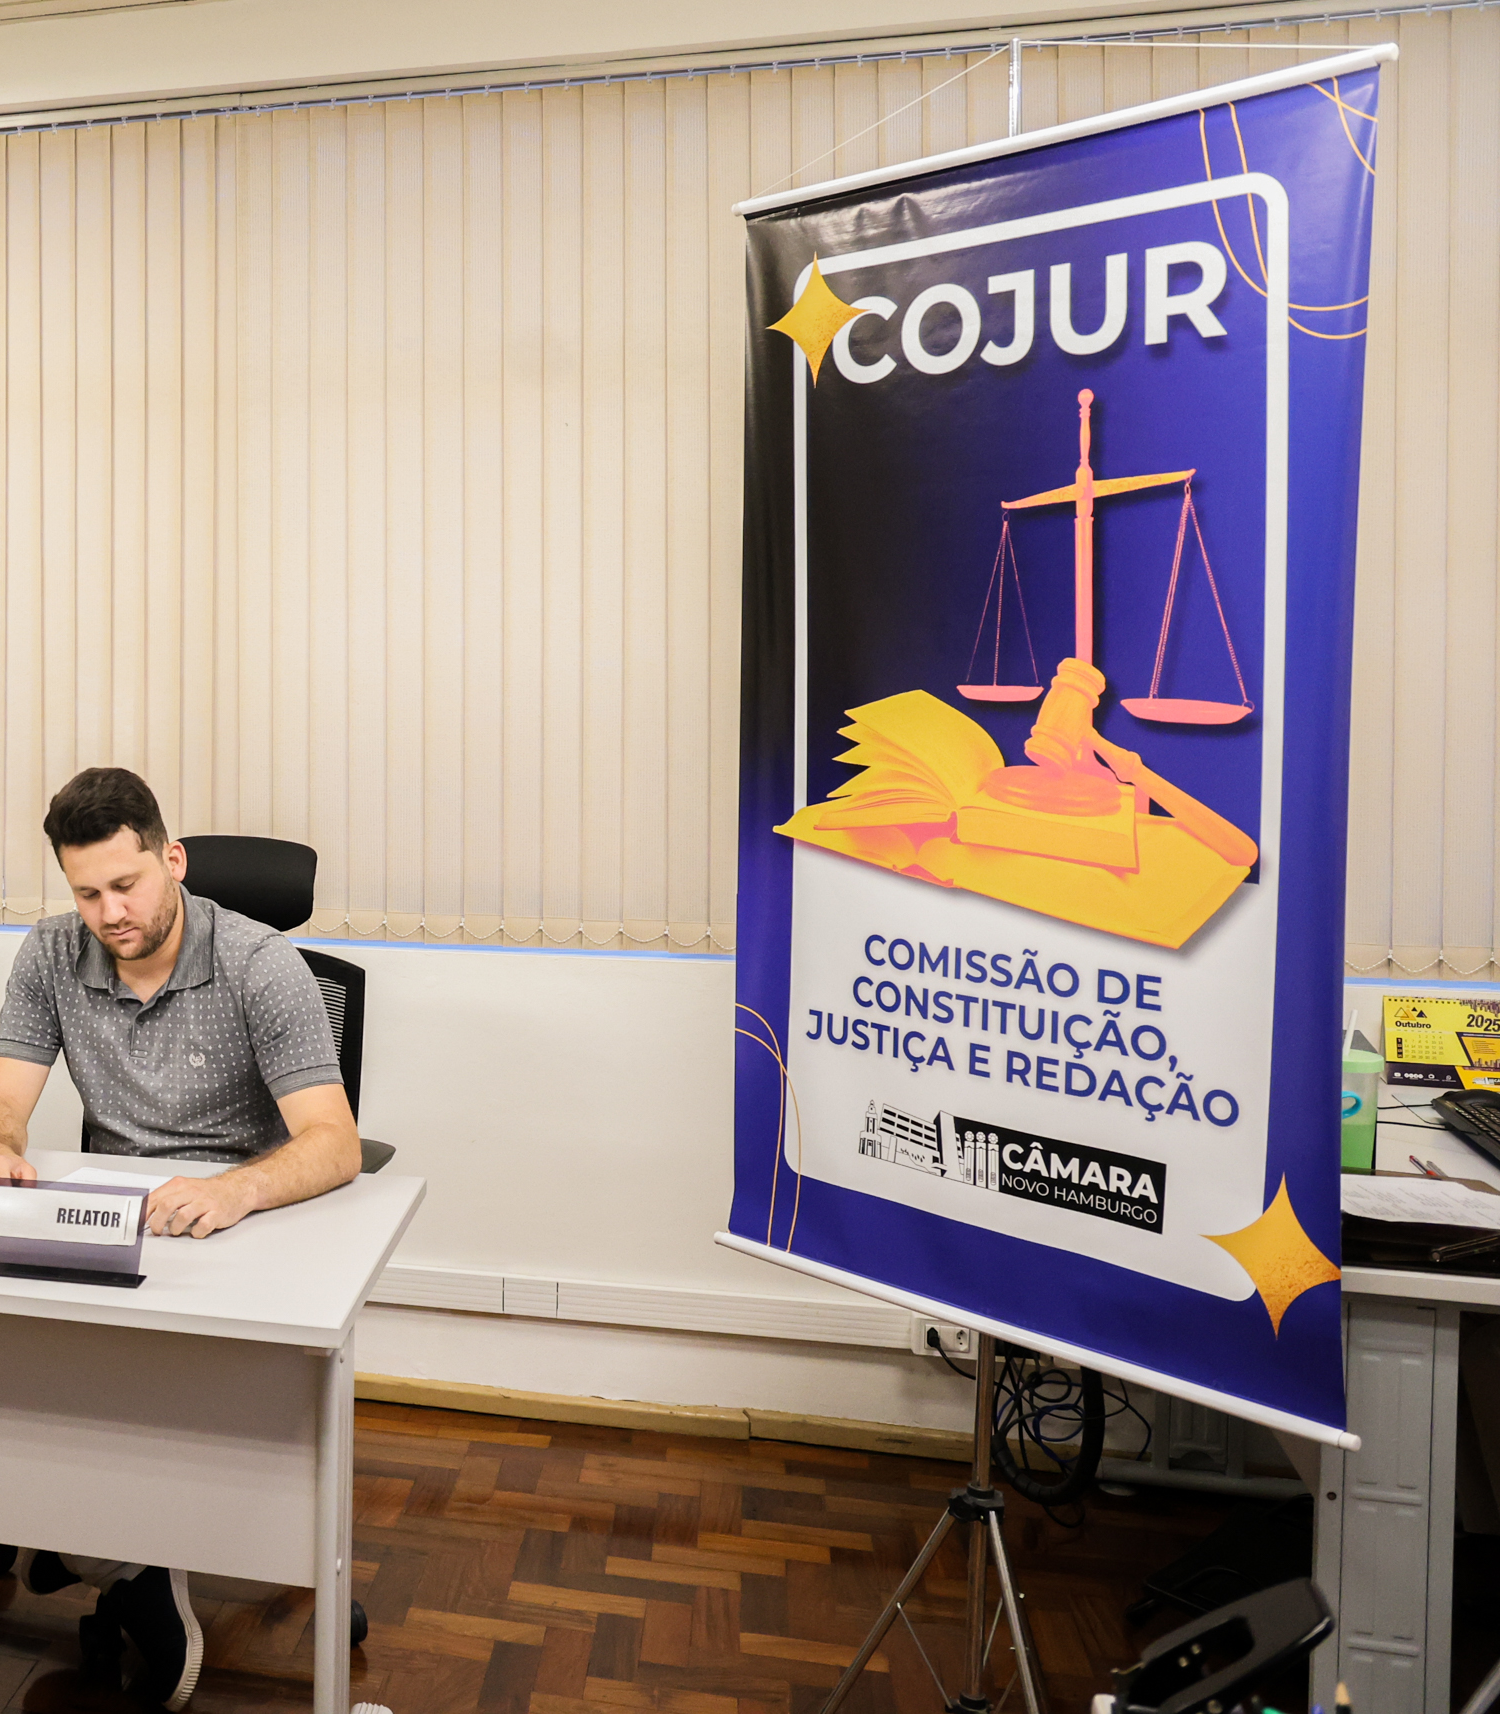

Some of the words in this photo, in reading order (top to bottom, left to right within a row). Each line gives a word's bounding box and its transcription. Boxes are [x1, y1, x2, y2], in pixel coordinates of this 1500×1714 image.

[831, 240, 1228, 385] COJUR
[864, 933, 1080, 999] COMISSÃO
[1097, 969, 1162, 1012] DE
[852, 975, 1179, 1072] CONSTITUIÇÃO,
[1395, 1020, 1432, 1029] Outubro
[1466, 1013, 1500, 1032] 2025
[806, 1009, 955, 1073] JUSTIÇA
[969, 1043, 991, 1078] E
[1007, 1050, 1241, 1128] REDAÇÃO
[1001, 1173, 1050, 1197] NOVO
[1054, 1186, 1157, 1224] HAMBURGO
[1002, 1141, 1159, 1204] CÂMARA
[56, 1207, 121, 1228] RELATOR
